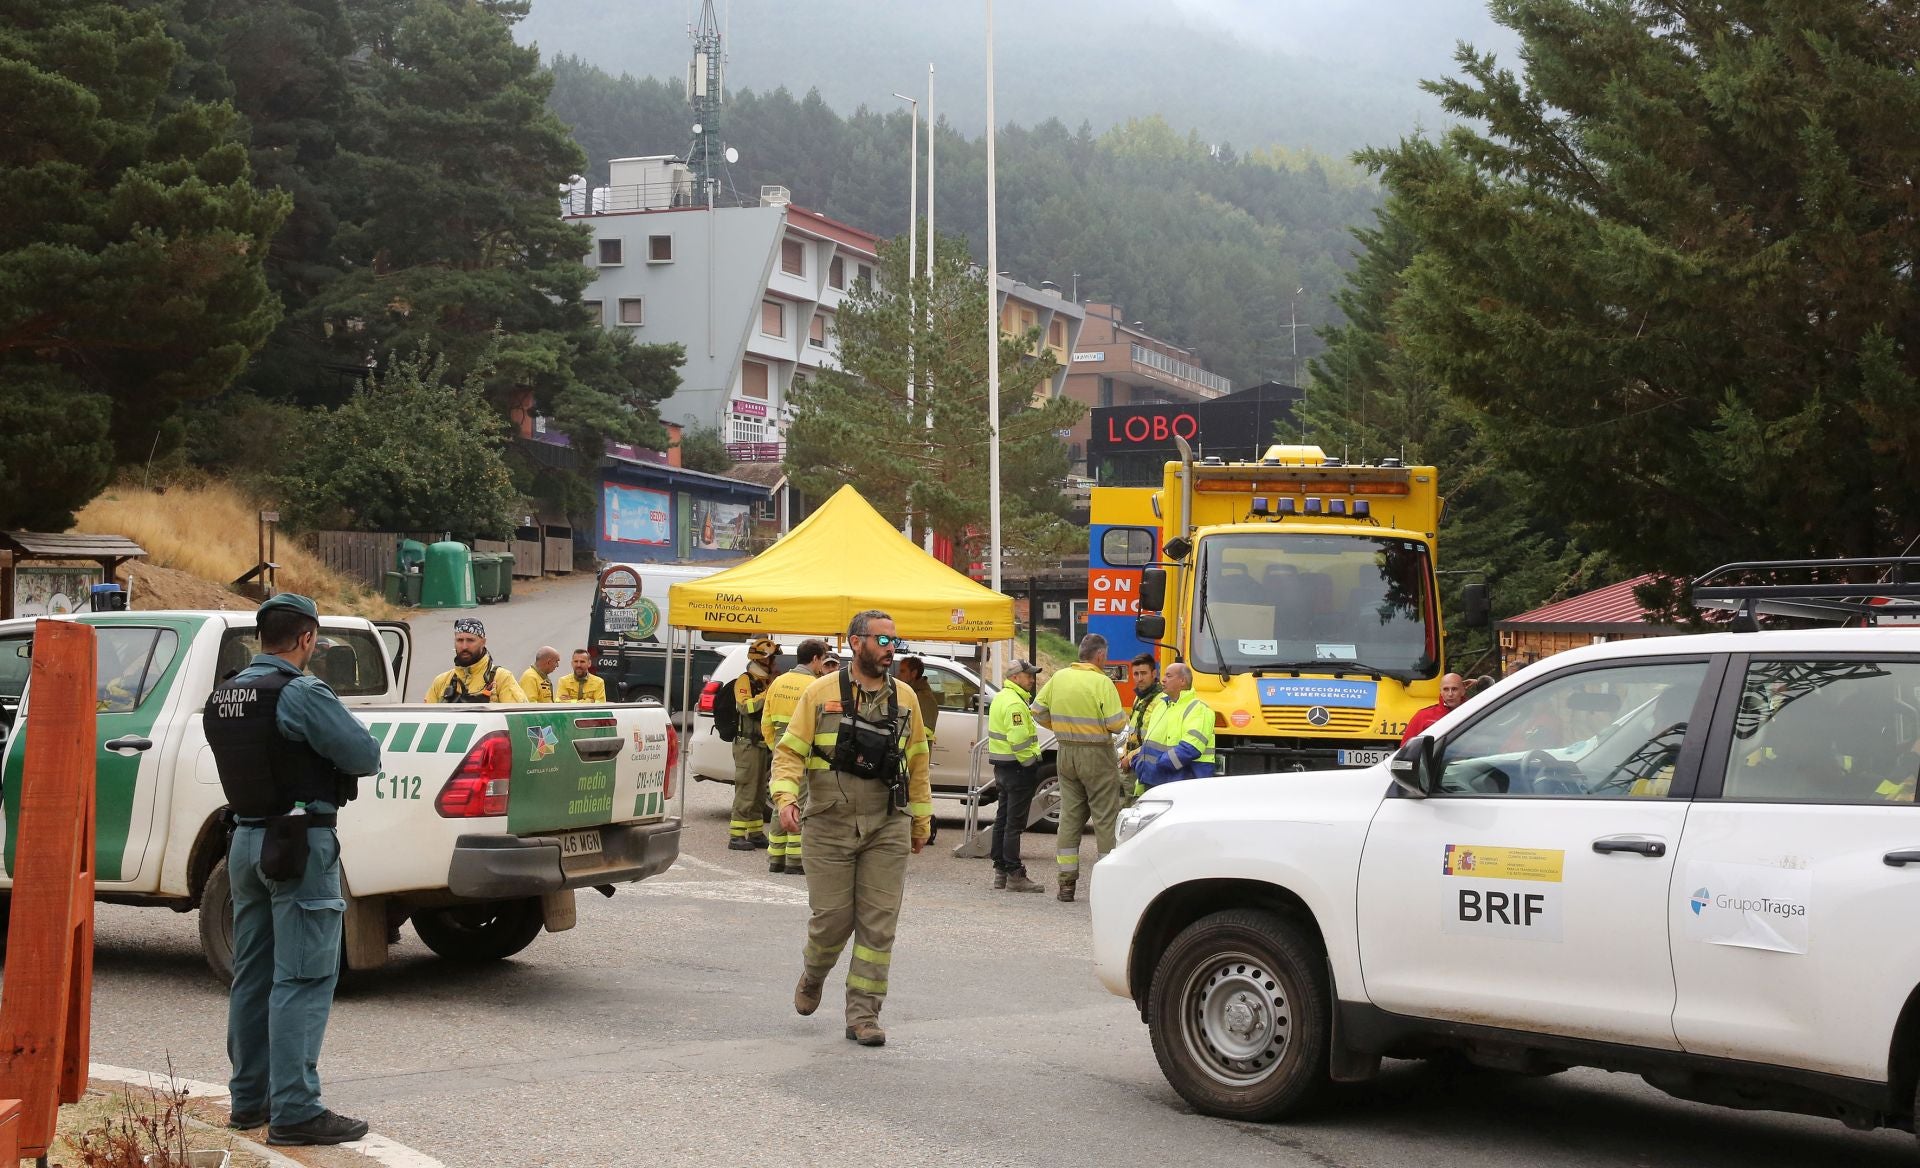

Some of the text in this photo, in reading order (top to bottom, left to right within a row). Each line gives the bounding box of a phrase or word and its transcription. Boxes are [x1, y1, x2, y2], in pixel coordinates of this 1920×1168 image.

[1108, 413, 1197, 442] LOBO
[1093, 574, 1131, 592] ÓN
[715, 592, 744, 602] PMA
[714, 603, 740, 611] Mando
[741, 605, 778, 613] Avanzado
[704, 611, 762, 624] INFOCAL
[212, 688, 257, 704] GUARDIA
[1295, 691, 1362, 699] EMERGENCIAS
[218, 702, 245, 718] CIVIL
[1348, 752, 1379, 764] 1085
[389, 775, 422, 800] 112
[577, 771, 607, 791] medio
[568, 793, 612, 815] ambiente
[580, 832, 600, 852] MGN
[1459, 889, 1544, 926] BRIF
[1716, 894, 1805, 918] GrupoTragsa
